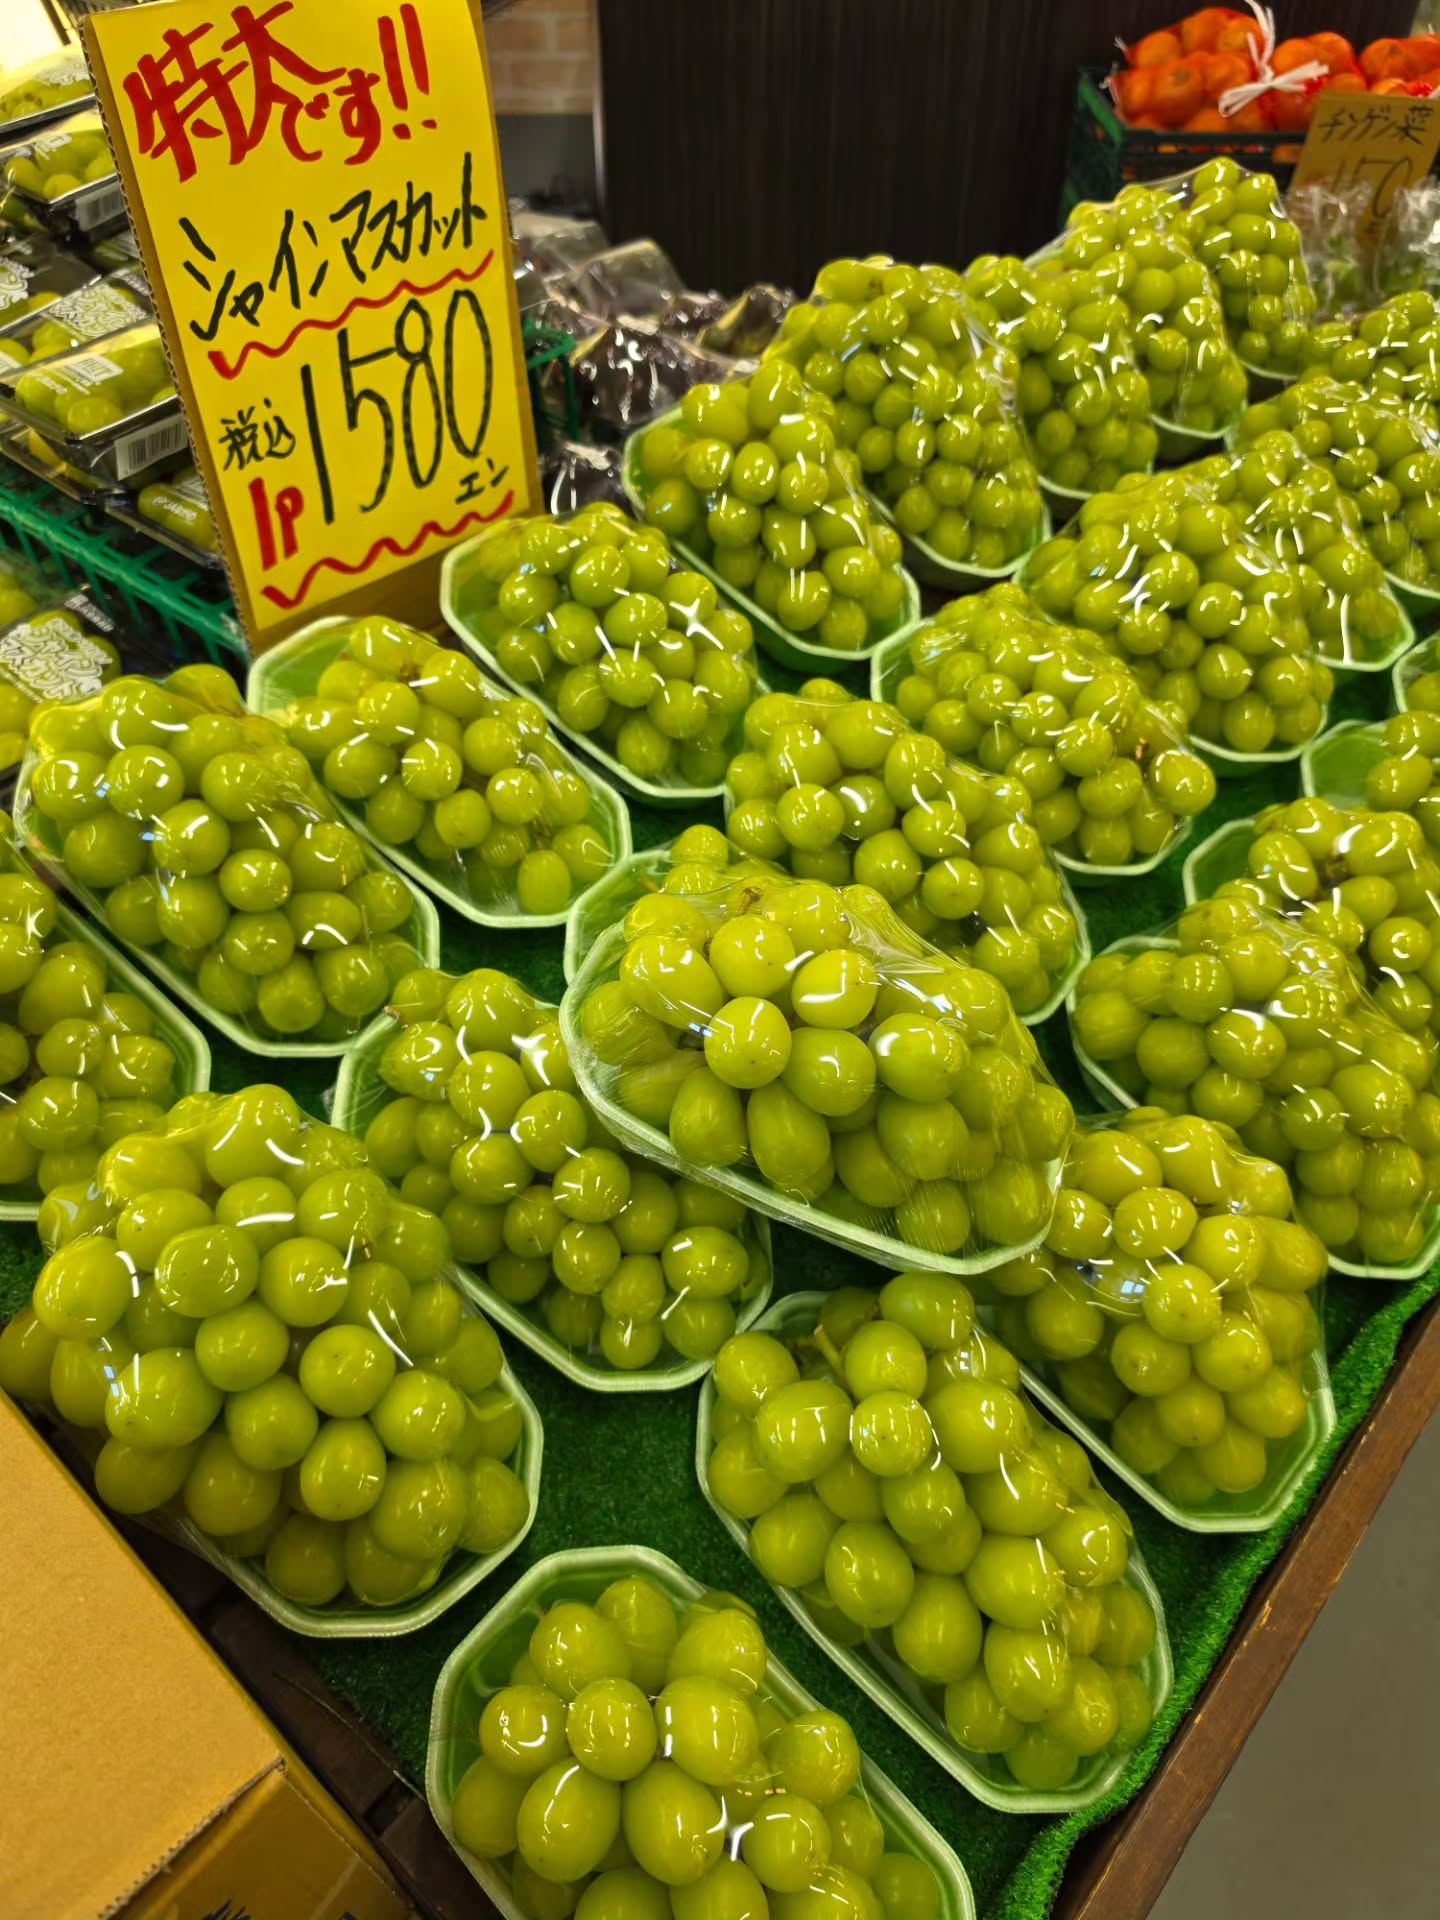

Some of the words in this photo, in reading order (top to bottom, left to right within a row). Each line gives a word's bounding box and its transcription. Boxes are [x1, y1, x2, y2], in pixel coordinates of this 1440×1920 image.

[179, 152, 486, 341] シャインマスカット
[220, 398, 298, 472] 税込
[300, 288, 494, 526] 1580
[456, 459, 511, 504] エン
[249, 478, 304, 570] 1P
